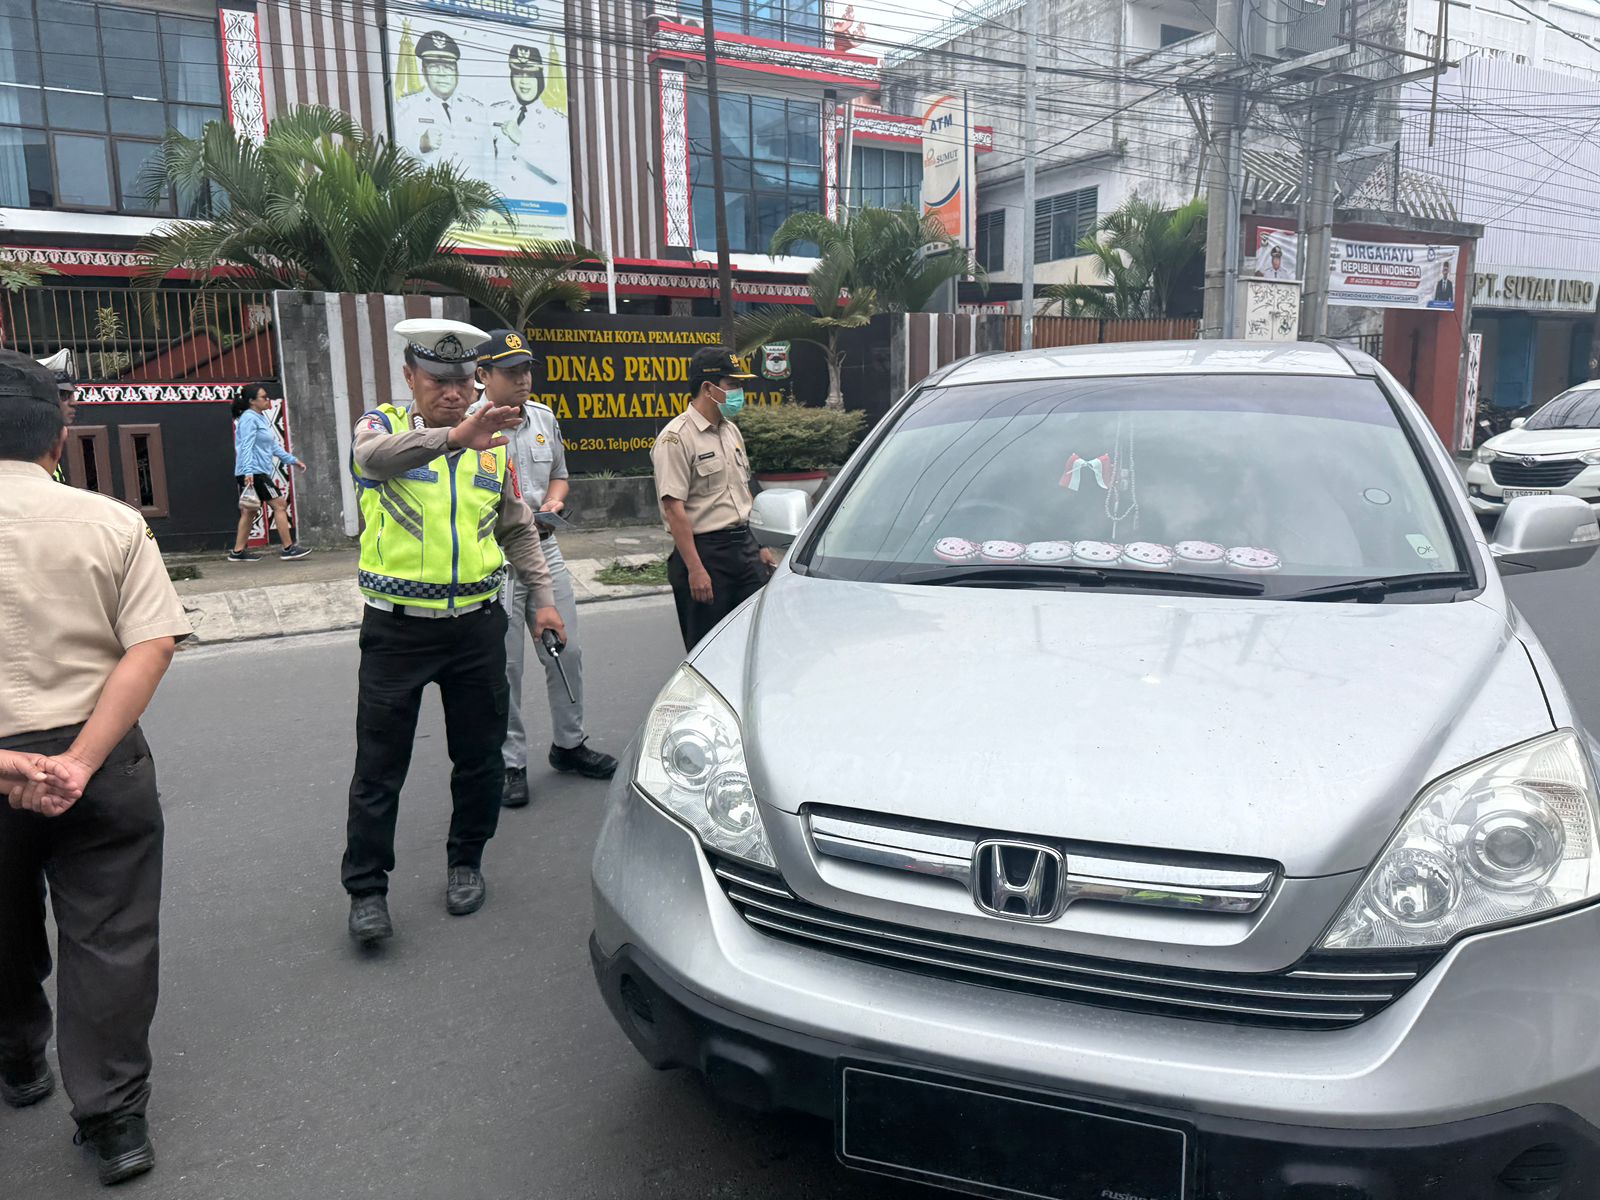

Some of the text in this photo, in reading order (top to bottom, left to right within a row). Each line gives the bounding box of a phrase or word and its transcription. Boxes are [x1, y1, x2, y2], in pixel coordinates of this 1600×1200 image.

[930, 113, 953, 134] ATM
[1345, 244, 1414, 263] DIRGAHAYU
[1342, 261, 1421, 278] REPUBLIK INDONESIA
[1474, 272, 1594, 304] PT. SUTAN INDO
[527, 328, 612, 343] PEMERINTAH
[614, 330, 647, 343] KOTA
[546, 355, 615, 382] DINAS
[563, 439, 578, 451] No
